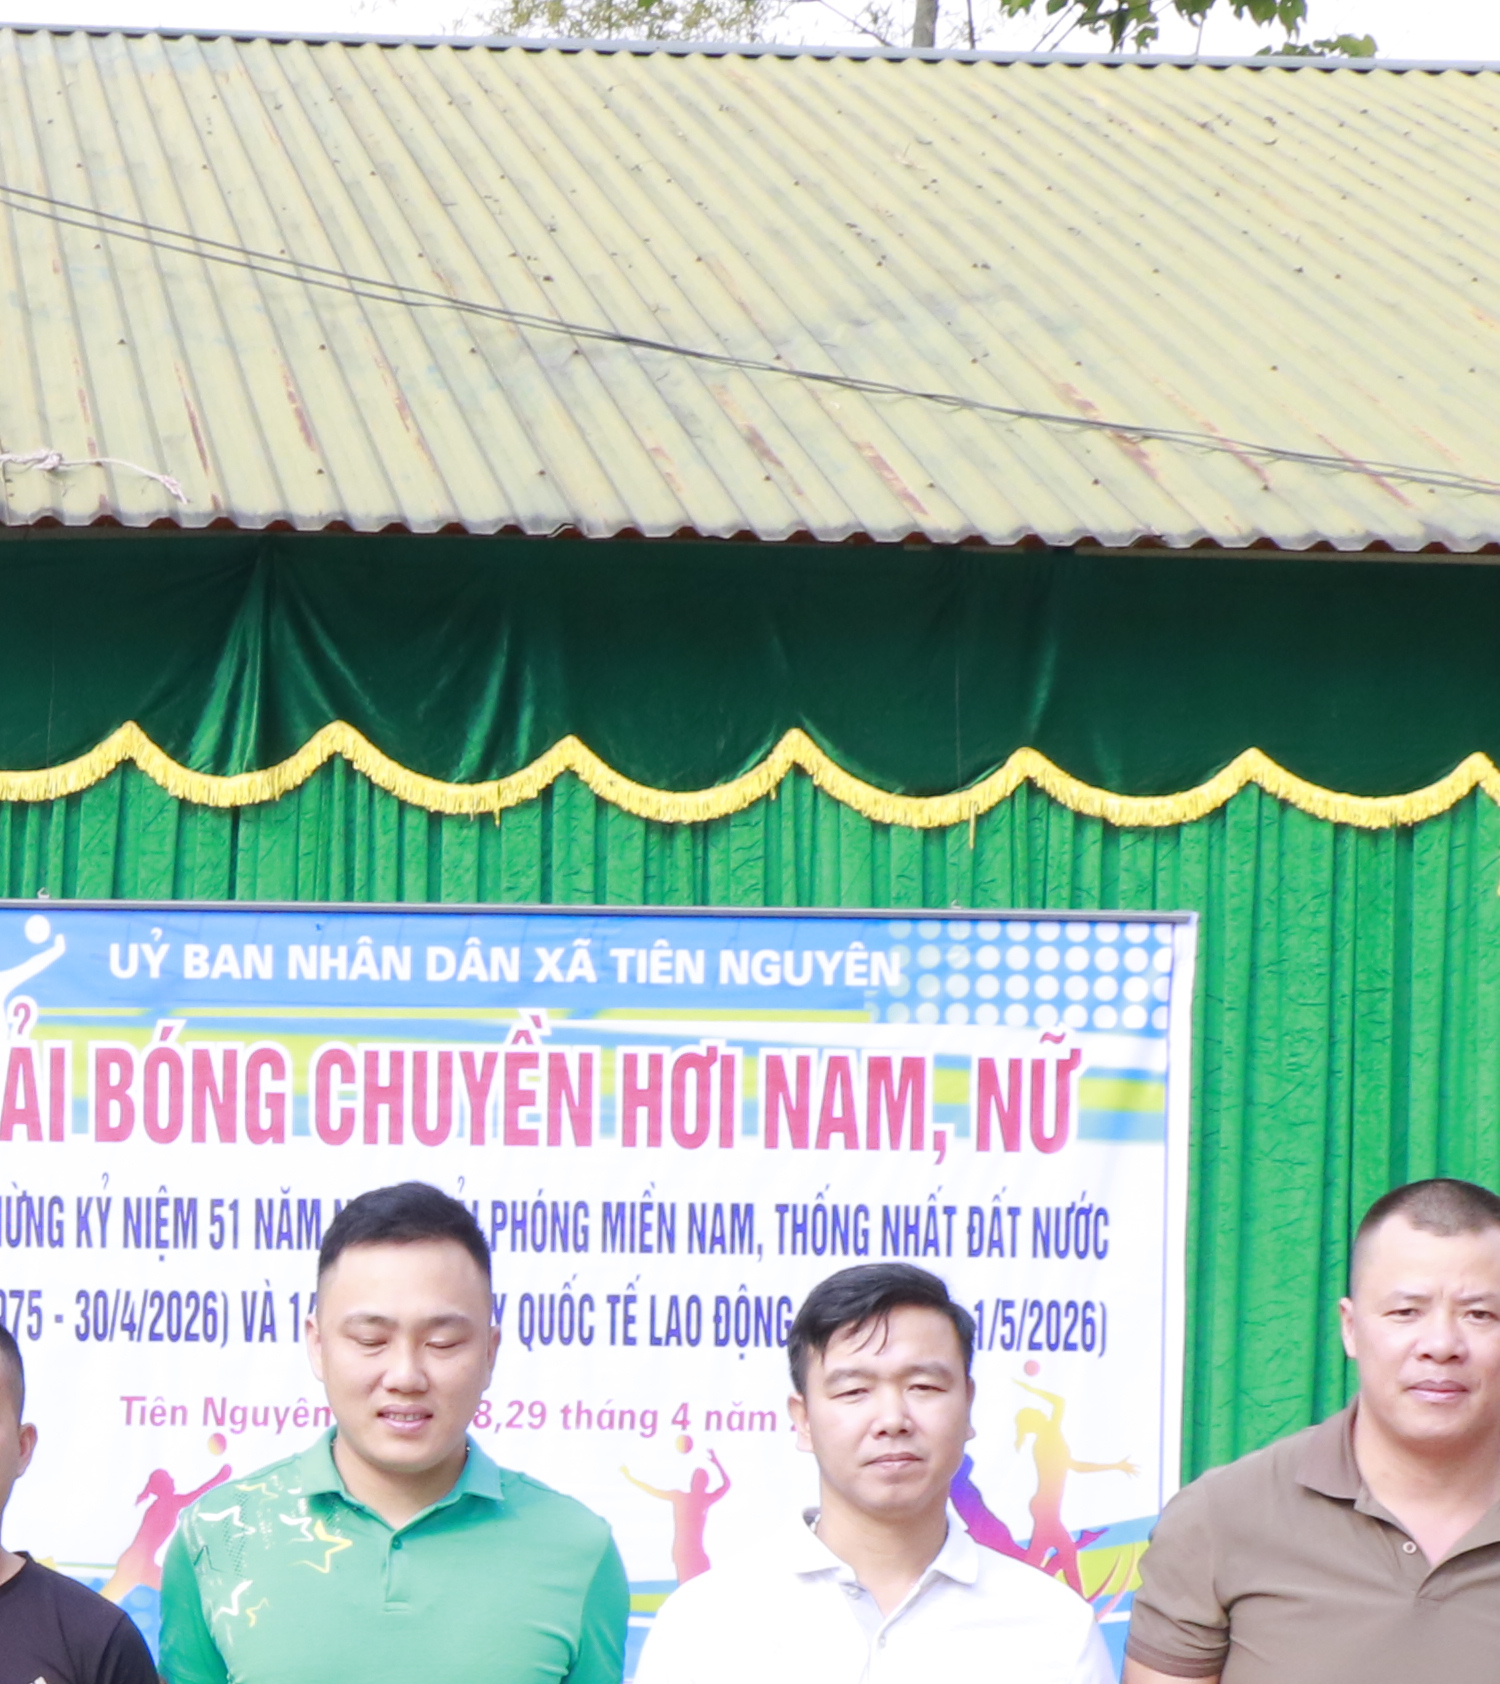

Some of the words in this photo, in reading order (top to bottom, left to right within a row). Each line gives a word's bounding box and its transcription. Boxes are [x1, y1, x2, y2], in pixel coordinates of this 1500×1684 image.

[184, 945, 272, 978] BAN
[288, 938, 410, 981] NHÂN
[427, 938, 519, 982] DÂN
[534, 939, 596, 983] XÃ
[610, 939, 704, 985] TIÊN
[720, 942, 899, 988] NGUYÊN
[95, 1026, 285, 1144] BÓNG
[314, 1015, 593, 1147] CHUYỀN
[622, 1046, 734, 1149] HƠI
[764, 1054, 946, 1164] NAM,
[977, 1031, 1082, 1153] NỮ
[77, 1172, 112, 1249] KỶ
[123, 1186, 198, 1262] NIỆM
[209, 1198, 238, 1250] 51
[254, 1186, 322, 1250] NĂM
[491, 1188, 590, 1253] PHÓNG
[601, 1182, 676, 1255] MIỀN
[689, 1202, 763, 1262] NAM,
[775, 1184, 869, 1257] THỐNG
[882, 1186, 956, 1257] NHẤT
[967, 1186, 1021, 1258] ĐẤT
[1032, 1191, 1109, 1260] NƯỚC
[74, 1288, 229, 1349] 30/4/2026)
[241, 1279, 278, 1343] VÀ
[517, 1274, 595, 1352] QUỐC
[606, 1271, 640, 1347] TẾ
[649, 1294, 701, 1348] LAO
[714, 1284, 792, 1360] ĐỘNG
[120, 1394, 188, 1428] Tiên
[203, 1396, 332, 1436] Nguyên
[473, 1400, 547, 1434] 8,29
[561, 1402, 658, 1438] tháng
[671, 1402, 691, 1432] 4
[705, 1401, 777, 1432] năm
